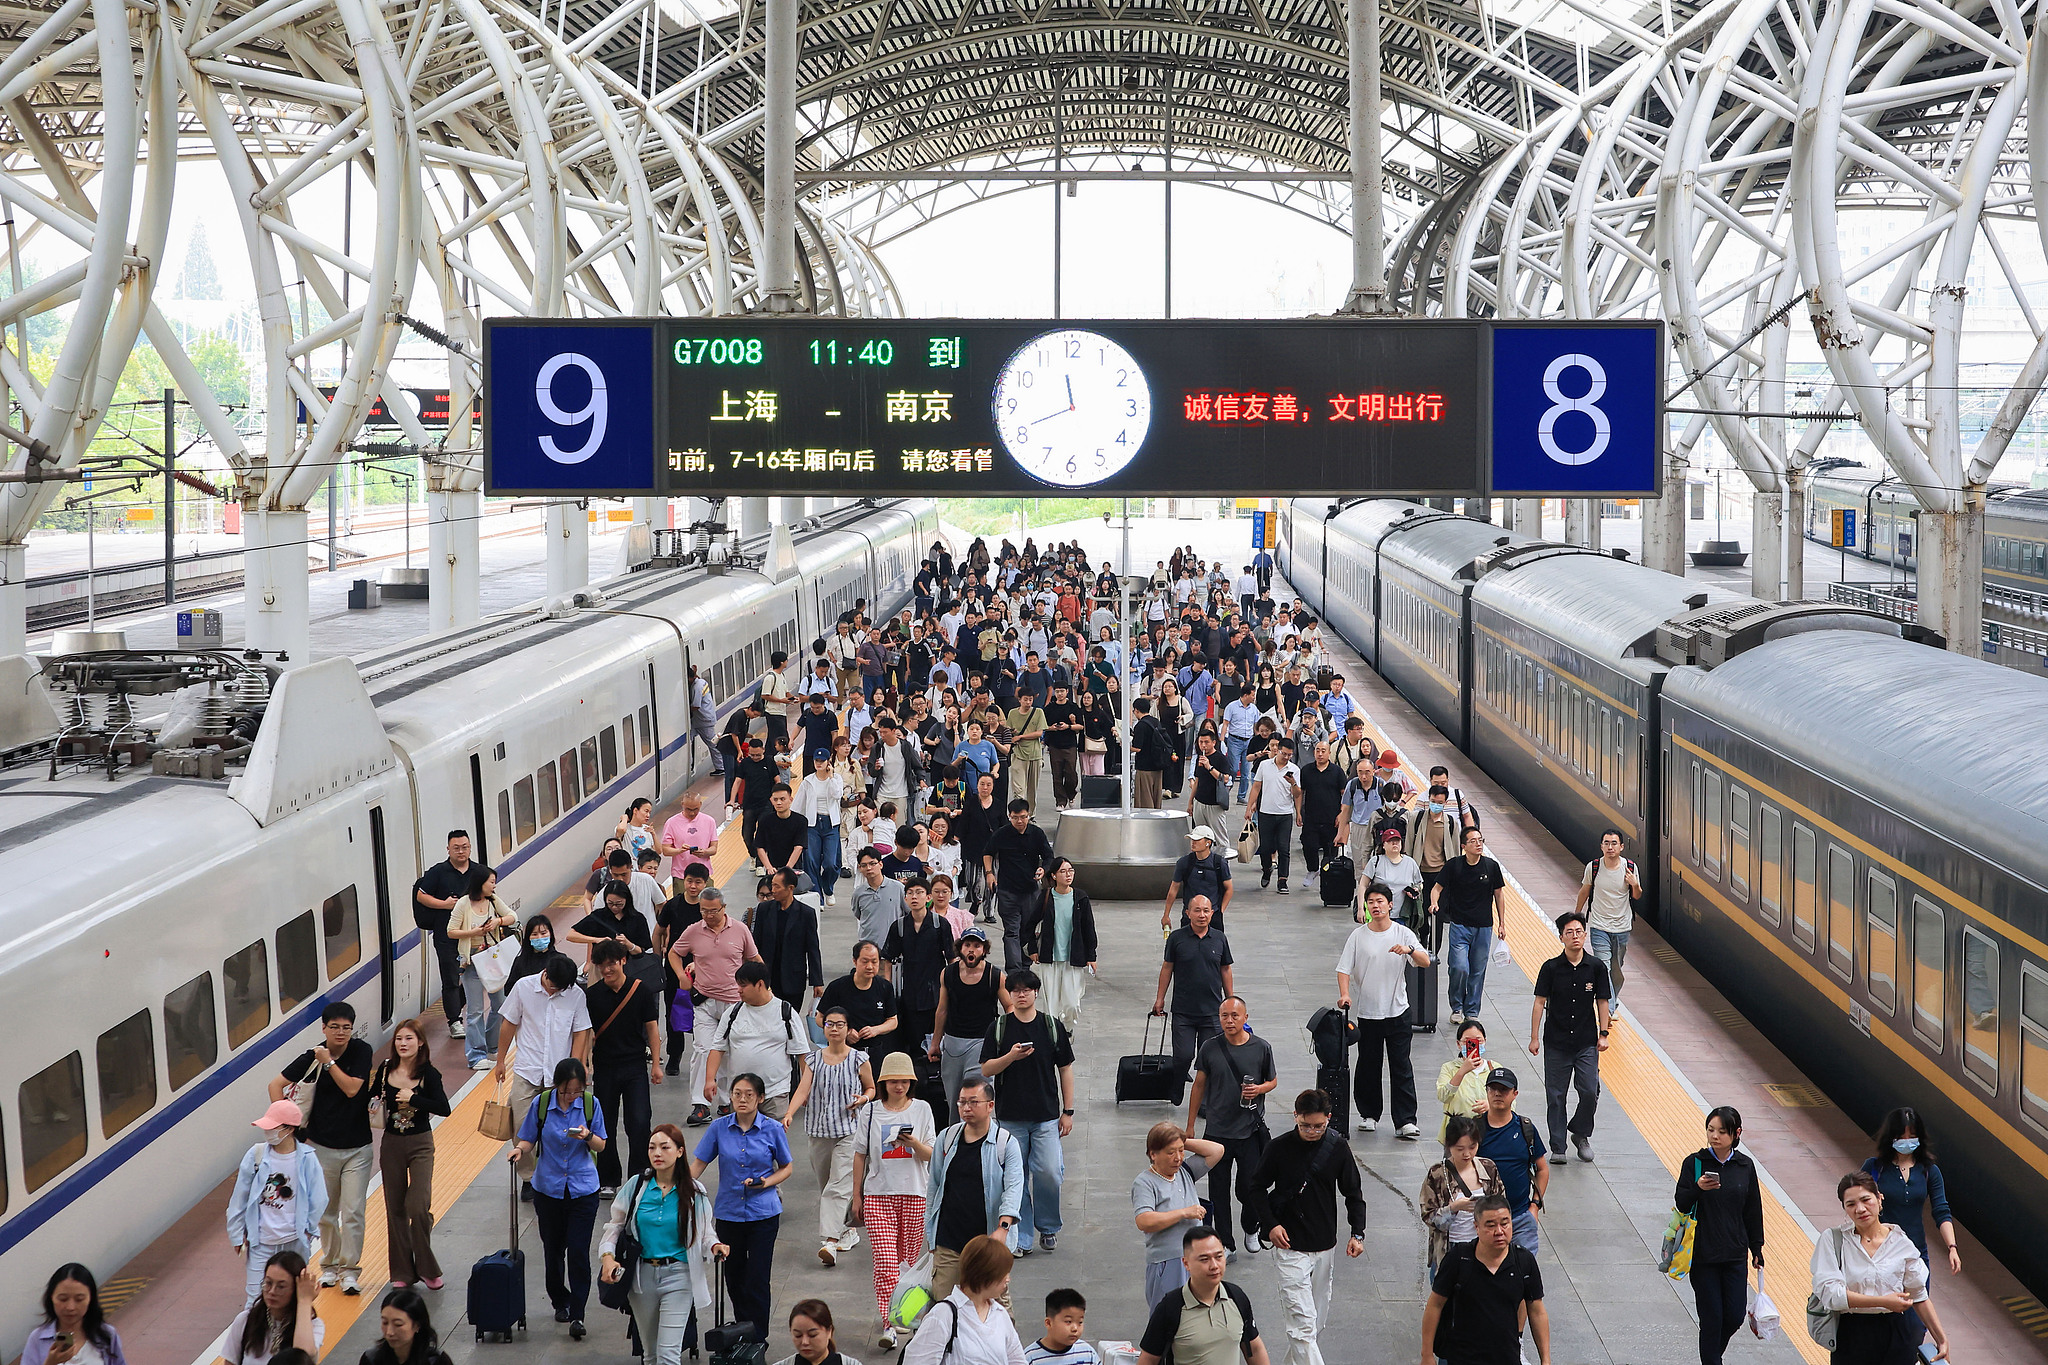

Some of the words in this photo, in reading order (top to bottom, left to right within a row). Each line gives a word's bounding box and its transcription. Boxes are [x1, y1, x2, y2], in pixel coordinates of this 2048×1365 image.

[673, 338, 763, 365] G7008
[809, 339, 893, 366] 11:40
[928, 336, 961, 369] 到
[1064, 340, 1081, 358] 12
[1099, 349, 1104, 366] 1
[1038, 350, 1050, 367] 11
[1016, 371, 1033, 388] 10
[1116, 368, 1127, 387] 2
[535, 352, 608, 465] 9
[710, 389, 779, 423] 上海
[886, 389, 954, 423] 南京
[1007, 398, 1018, 415] 9
[1125, 399, 1137, 417] 3
[1183, 393, 1445, 423] 诚信友善，文明出行
[1537, 353, 1611, 466] 8
[1016, 426, 1028, 444] 8
[1115, 428, 1127, 447] 4
[900, 448, 993, 473] 请您看管
[1042, 447, 1053, 464] 7
[1065, 454, 1077, 473] 6
[1094, 448, 1105, 466] 5
